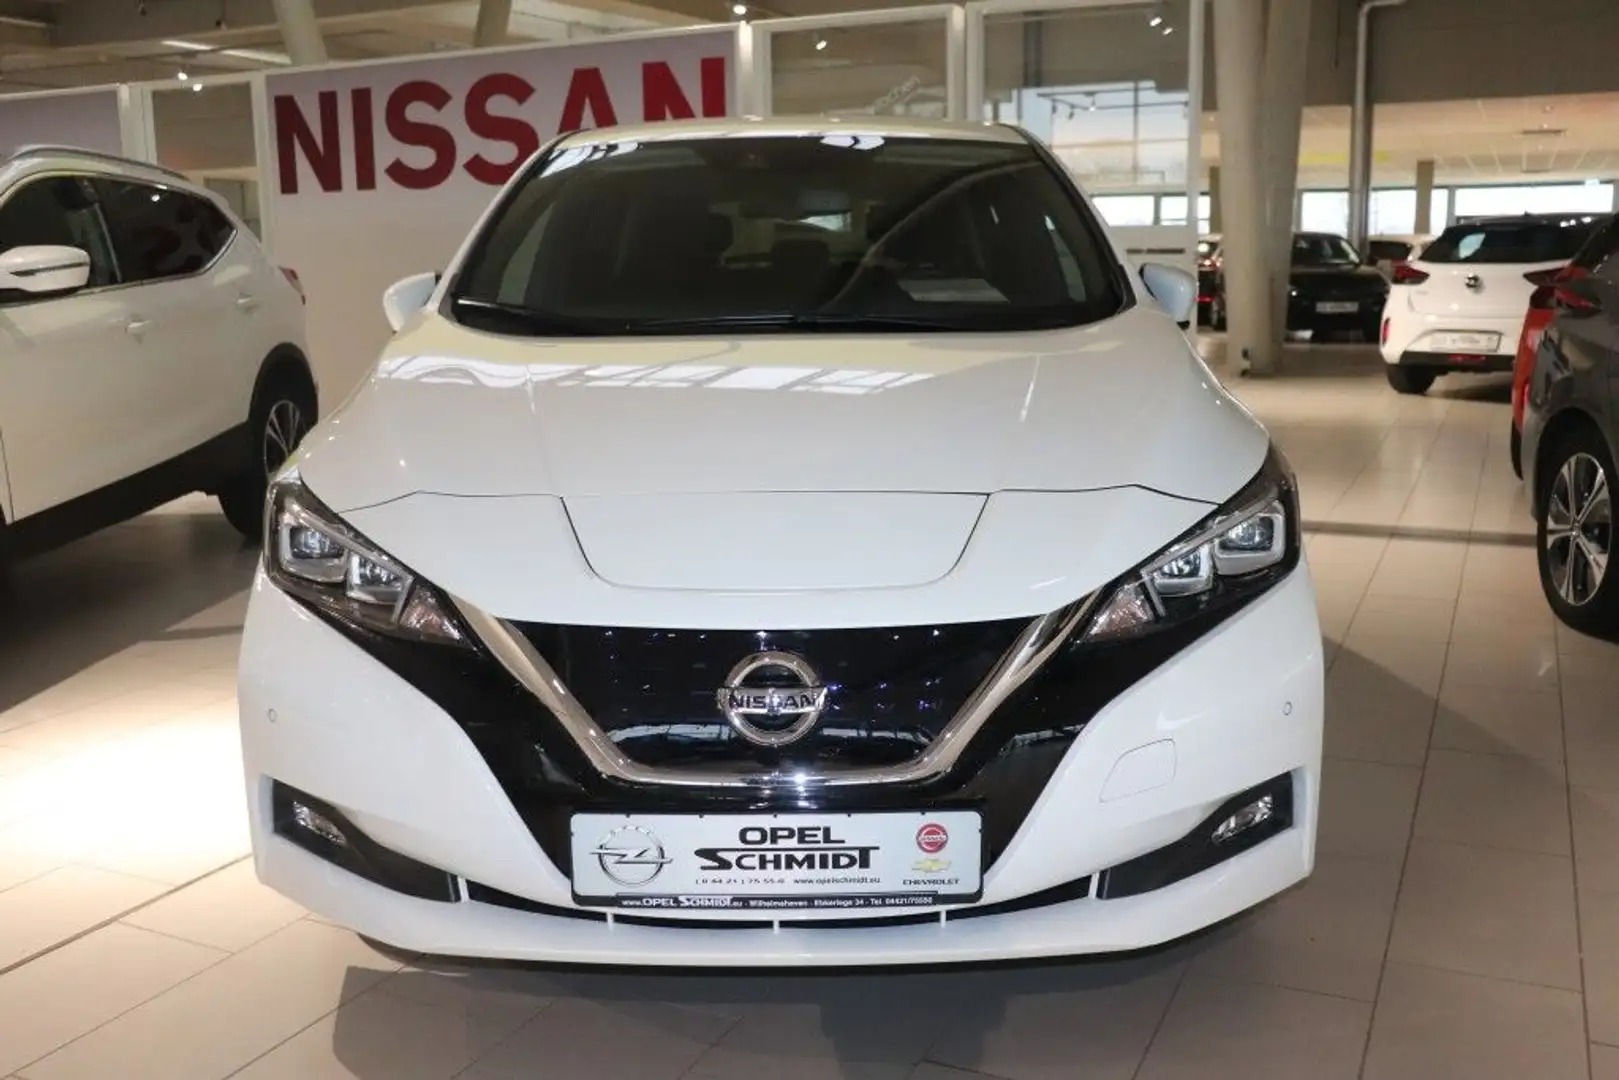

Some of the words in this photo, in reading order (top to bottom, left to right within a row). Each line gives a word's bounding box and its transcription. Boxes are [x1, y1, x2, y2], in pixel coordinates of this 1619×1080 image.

[274, 57, 726, 194] NISSAN
[728, 694, 816, 709] NISSAN
[739, 826, 846, 845] OPEL
[694, 846, 880, 870] SCHMIDT
[902, 878, 960, 886] CHEVROLET
